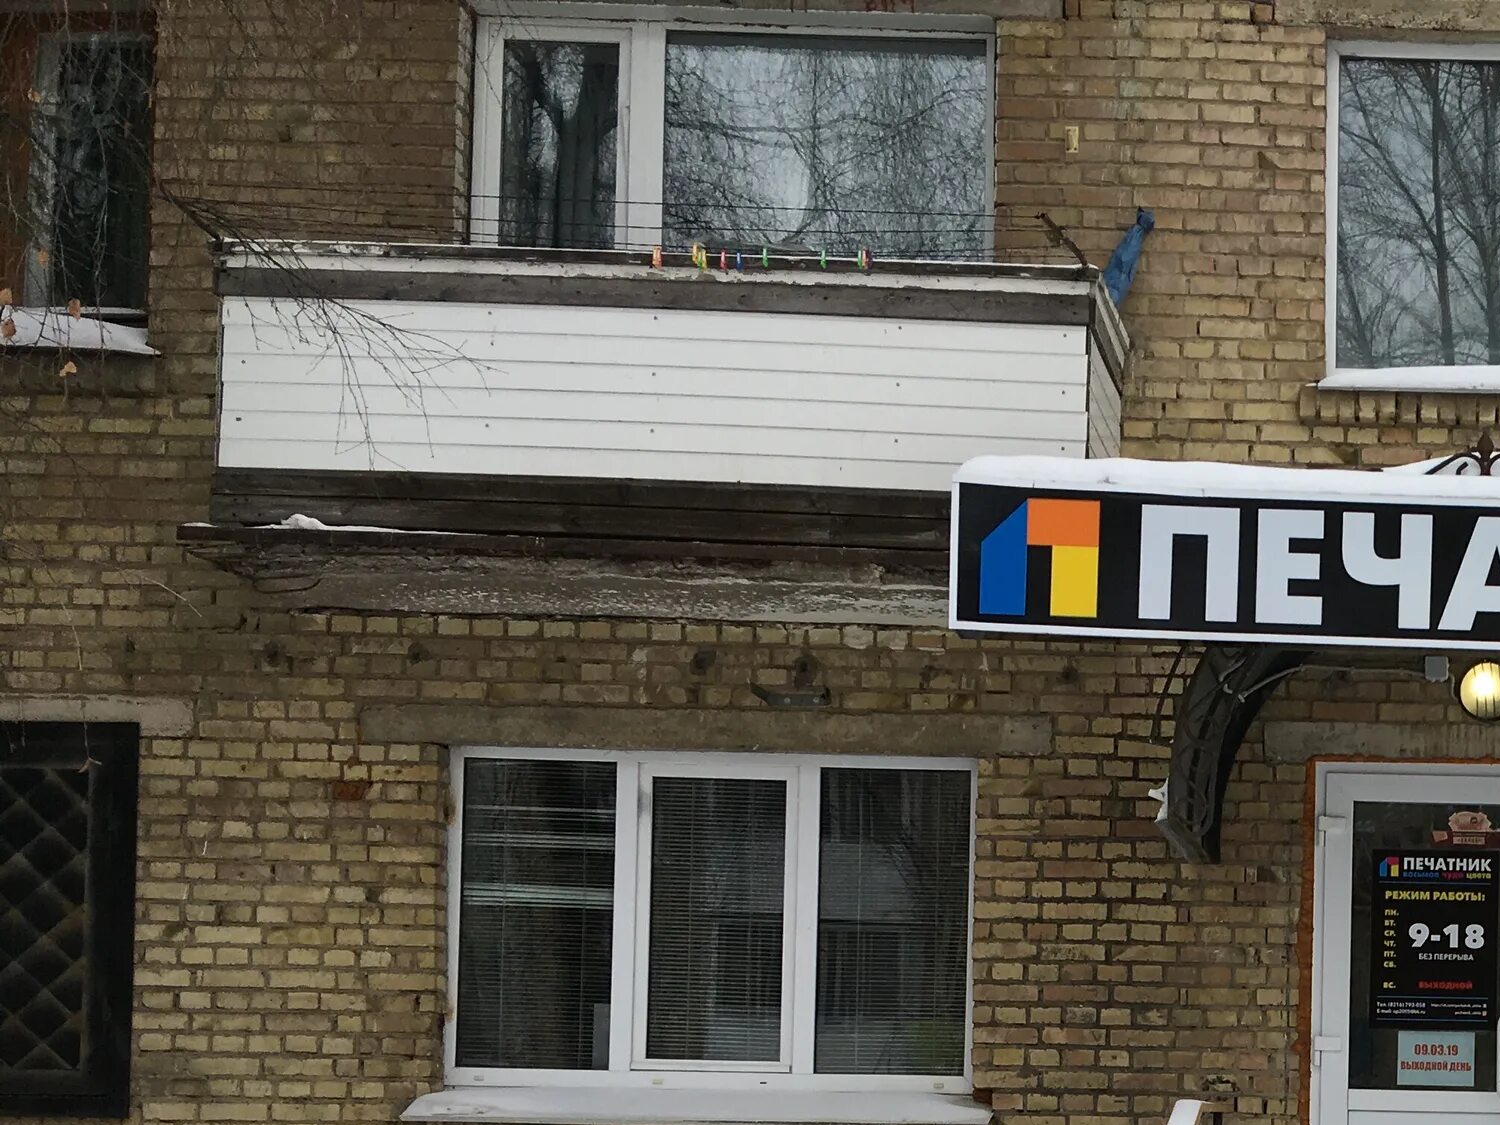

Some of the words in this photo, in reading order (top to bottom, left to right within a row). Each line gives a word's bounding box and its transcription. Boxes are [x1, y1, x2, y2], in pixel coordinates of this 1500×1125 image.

[1403, 857, 1492, 872] ПЕЧАТНИК
[1385, 890, 1430, 900] РЕЖИМ
[1432, 891, 1486, 902] РАБОТЫ:
[1408, 922, 1485, 949] 9-18
[1433, 953, 1474, 961] ПЕРЕРЫВА
[1414, 1044, 1459, 1055] 09.03.19
[1400, 1061, 1448, 1071] ВЫХОДНОЙ
[1449, 1062, 1472, 1072] ДЕНЬ
